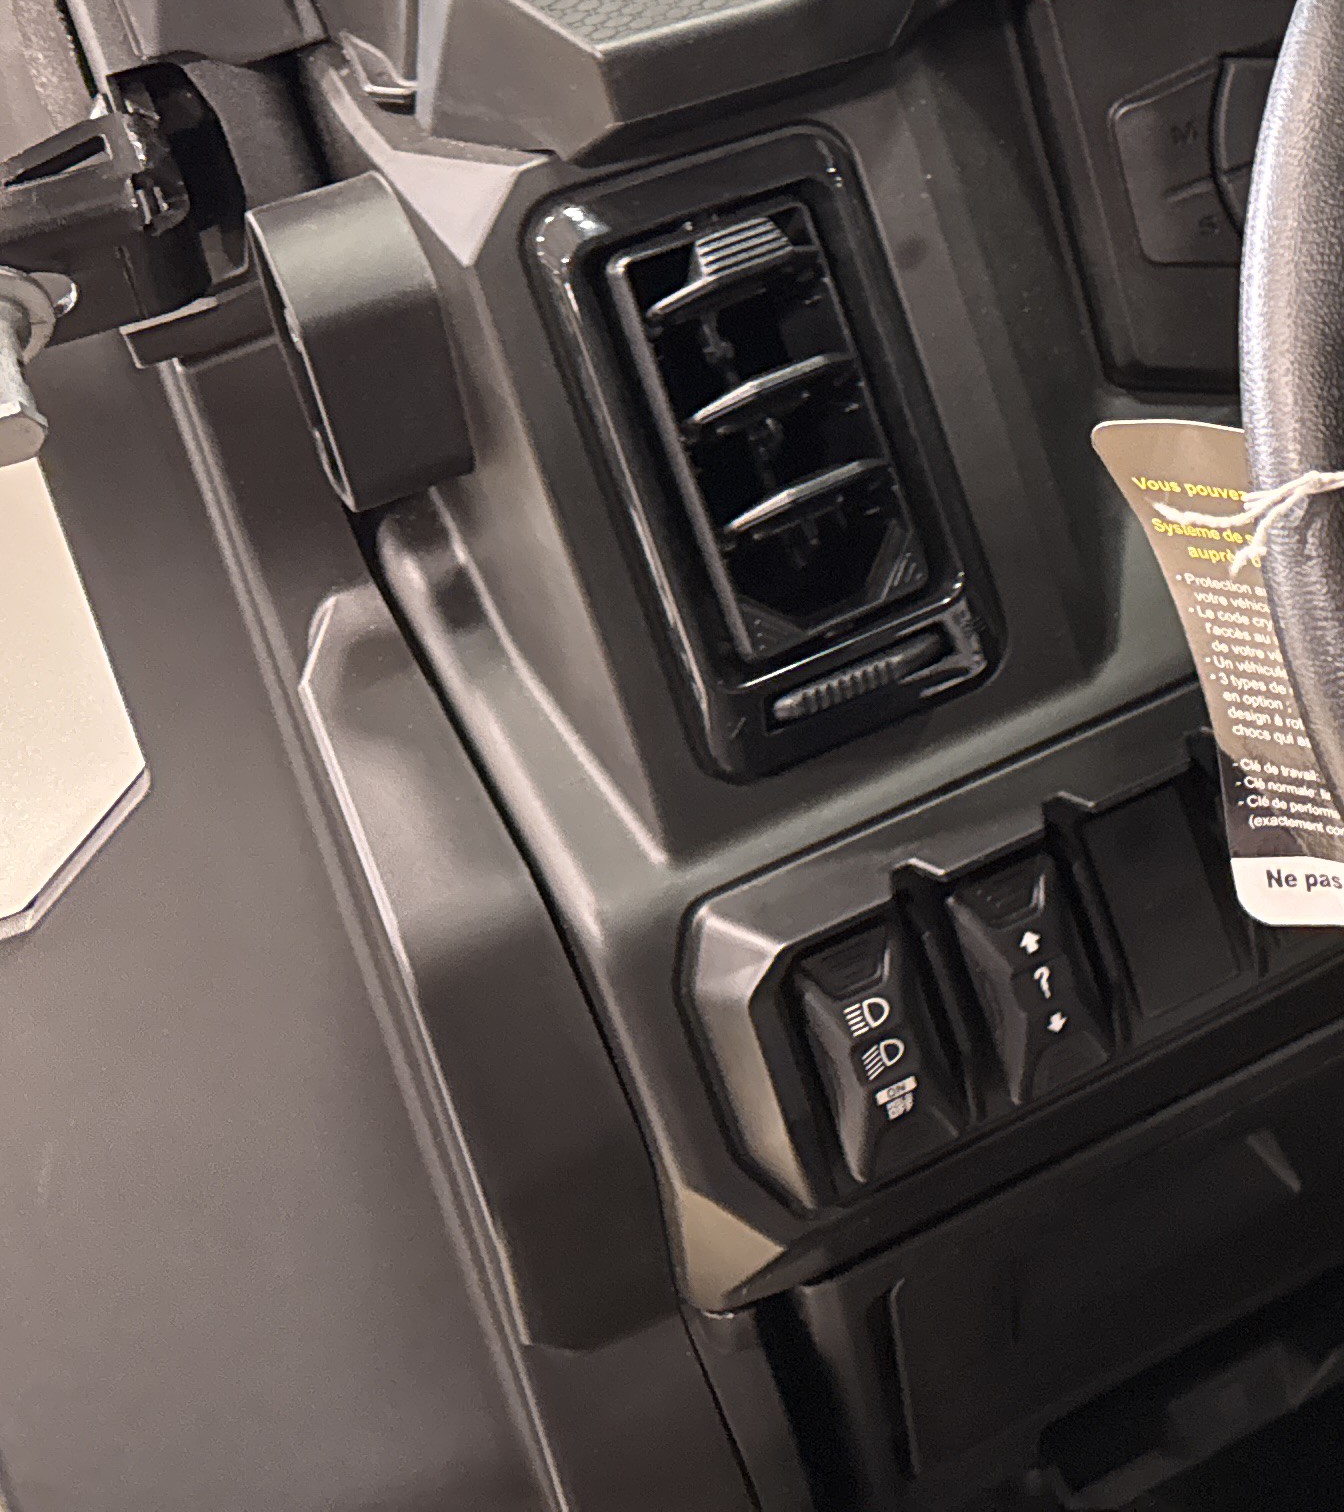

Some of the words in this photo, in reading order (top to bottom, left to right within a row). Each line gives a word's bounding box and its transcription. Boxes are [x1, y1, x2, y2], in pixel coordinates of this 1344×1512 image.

[1131, 476, 1182, 494] Vous
[1222, 528, 1244, 544] de
[1183, 572, 1252, 595] Protection
[1193, 591, 1229, 607] votre
[1196, 605, 1216, 620] Le
[1217, 609, 1251, 626] code
[1253, 633, 1272, 646] au
[1211, 639, 1230, 654] de
[1230, 643, 1266, 660] votre
[1212, 654, 1235, 670] Un
[1218, 672, 1229, 685] 3
[1229, 673, 1267, 692] types
[1268, 681, 1288, 695] de
[1222, 691, 1241, 704] en
[1242, 693, 1284, 711] option
[1227, 705, 1272, 726] design
[1231, 723, 1272, 741] chocs
[1273, 731, 1295, 746] qui
[1239, 758, 1262, 772] Clé
[1263, 761, 1280, 776] de
[1243, 775, 1266, 790] Clé
[1246, 794, 1271, 808] Clé
[1271, 797, 1288, 811] de
[1265, 868, 1298, 889] Ne
[1304, 872, 1343, 893] pas
